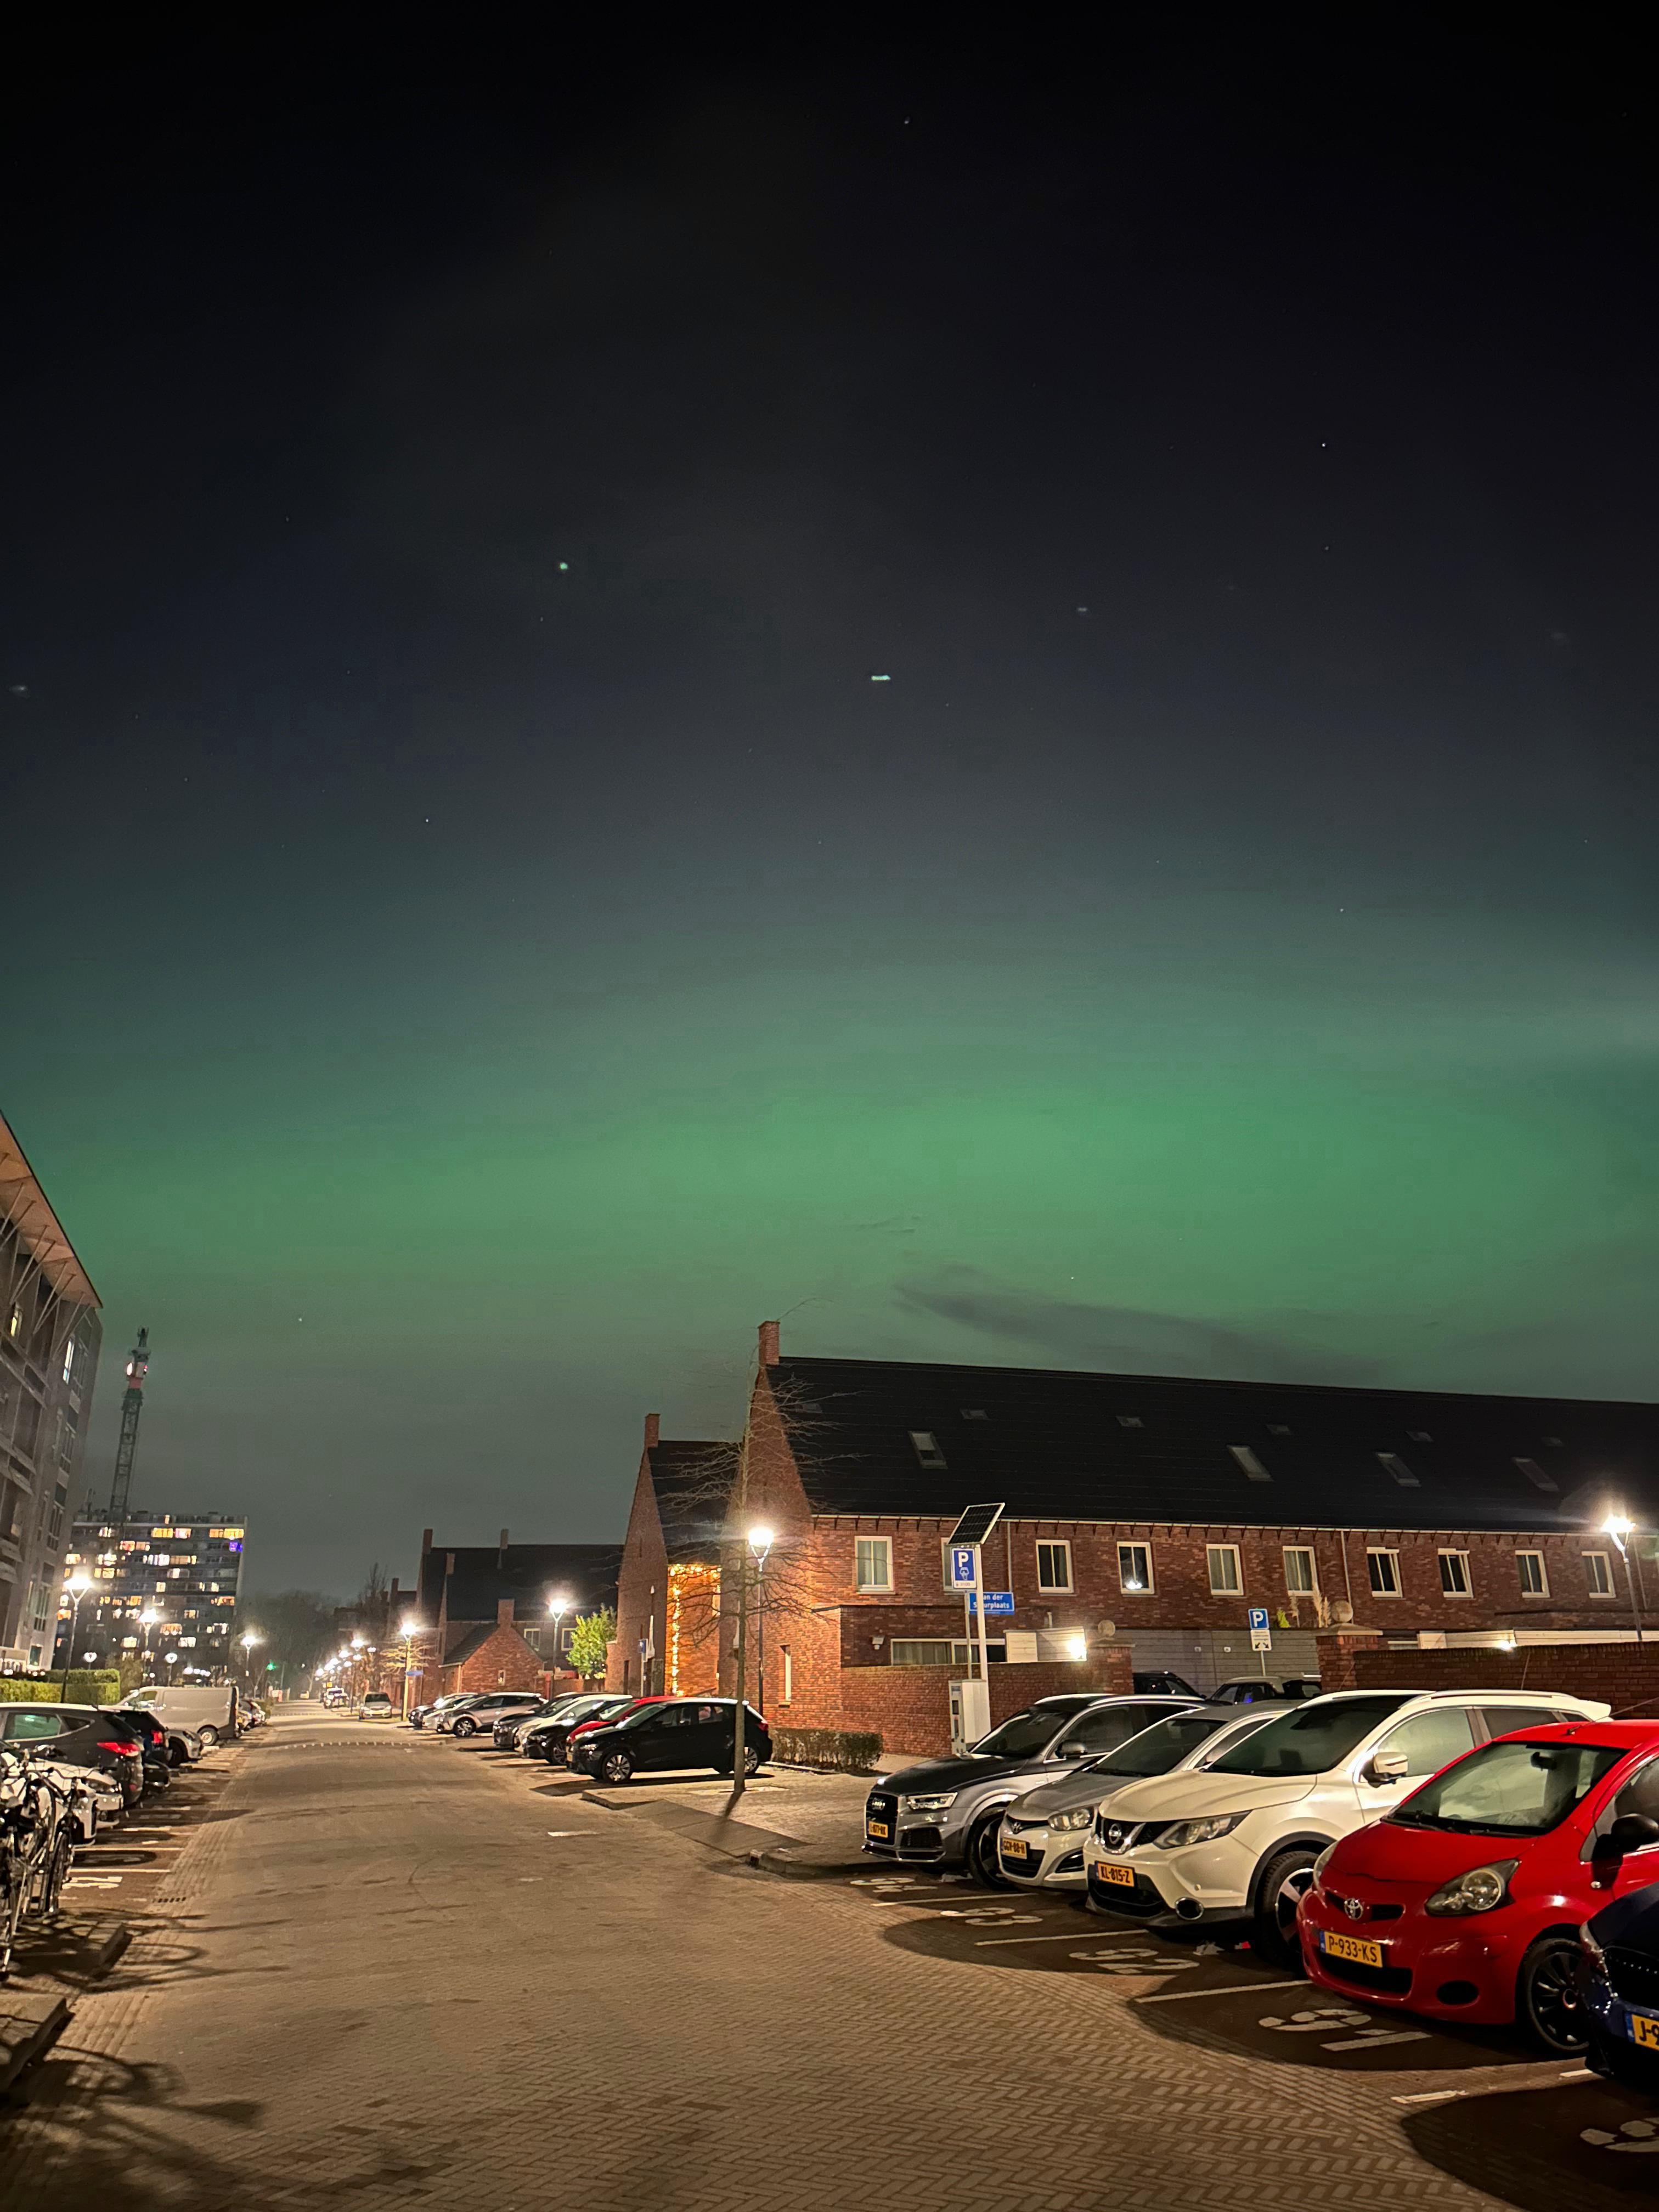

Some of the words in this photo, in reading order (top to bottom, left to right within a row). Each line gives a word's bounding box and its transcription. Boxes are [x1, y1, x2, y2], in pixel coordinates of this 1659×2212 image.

[958, 1552, 969, 1567] P
[973, 1601, 1010, 1610] Surplaats
[1252, 1611, 1263, 1627] P
[940, 1907, 1043, 1926] 93
[1328, 1935, 1378, 1963] P-933-KS
[1069, 1948, 1200, 1974] 92
[1258, 2008, 1433, 2052] 91
